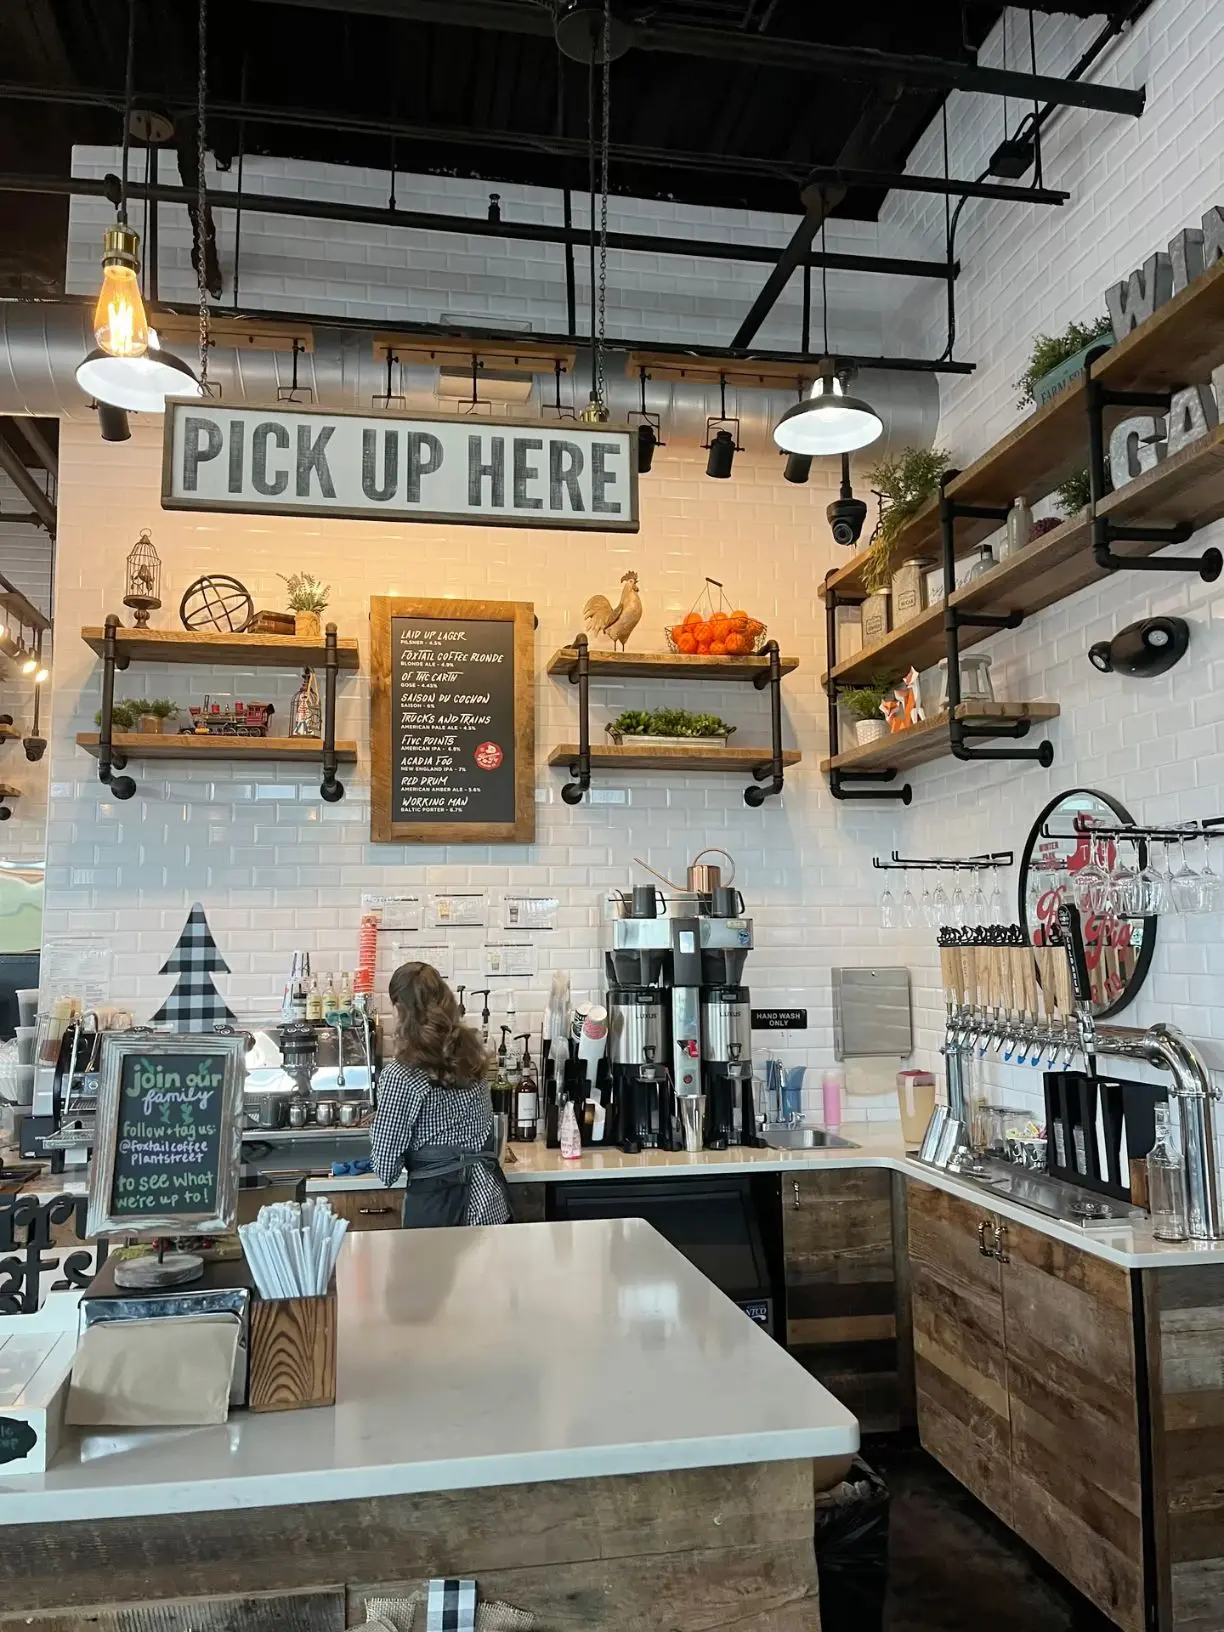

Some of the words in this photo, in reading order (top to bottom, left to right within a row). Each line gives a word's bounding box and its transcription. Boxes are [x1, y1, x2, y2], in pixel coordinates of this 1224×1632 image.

[182, 416, 338, 499] PICK
[361, 428, 445, 503] UP
[467, 434, 622, 514] HERE
[400, 630, 421, 639] LAID
[423, 631, 436, 640] UP
[437, 631, 467, 641] LAGER
[401, 650, 434, 661] FOXTAIL
[437, 651, 469, 662] COFFEE
[470, 653, 504, 663] BLONDE
[401, 672, 414, 681] OF
[416, 671, 431, 682] THE
[431, 671, 464, 682] EARTH
[401, 693, 436, 703] SAISON
[438, 694, 452, 703] DU
[454, 693, 491, 704] COCHON
[401, 712, 435, 724] TRUCKS
[438, 714, 459, 724] AND
[460, 713, 492, 725] TRAINS
[401, 735, 421, 745] FIVE
[422, 735, 458, 746] POINTS
[401, 756, 433, 766] ACADIA
[435, 755, 453, 766] FOG
[401, 776, 419, 786] RED
[420, 776, 449, 786] DRUM
[402, 797, 445, 808] WORKING
[447, 796, 469, 807] MAN
[756, 1012, 778, 1020] HAND
[126, 1064, 181, 1097] join
[186, 1071, 222, 1087] our
[142, 1087, 214, 1115] family
[174, 1124, 196, 1140] tag
[117, 1174, 135, 1192] to
[139, 1173, 169, 1191] see
[116, 1194, 156, 1208] we're
[159, 1194, 179, 1206] up
